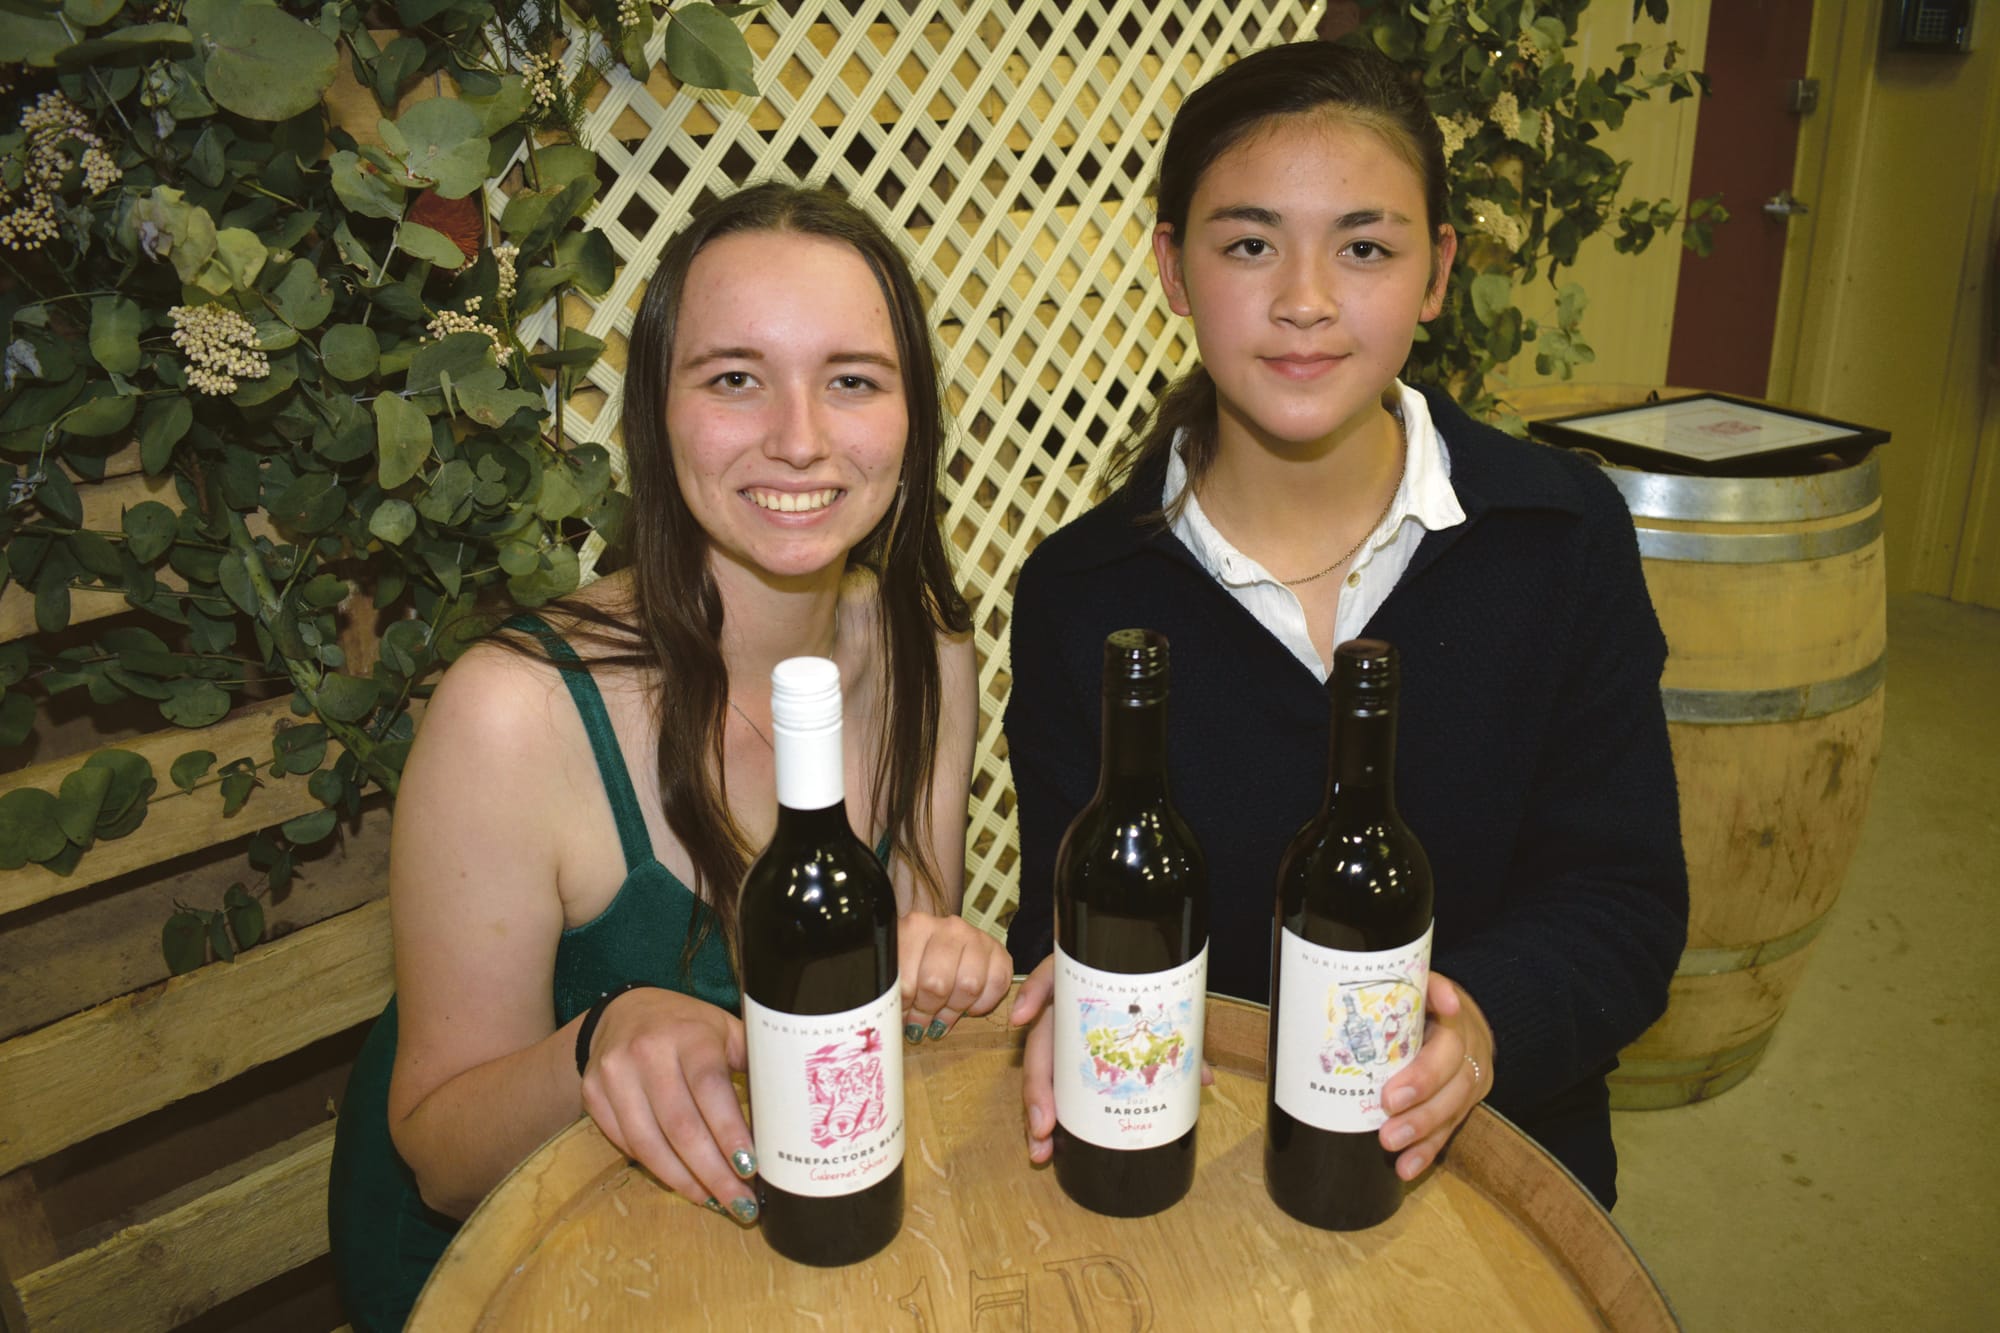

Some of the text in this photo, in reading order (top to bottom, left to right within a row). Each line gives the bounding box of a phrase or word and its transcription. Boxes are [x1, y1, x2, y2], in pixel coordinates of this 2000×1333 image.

[1310, 1081, 1375, 1097] BAROSSA
[1104, 1103, 1168, 1115] BAROSSA
[1118, 1117, 1153, 1133] Shiraz
[777, 1146, 876, 1166] BENEFACTORS
[809, 1166, 857, 1182] Cabernet
